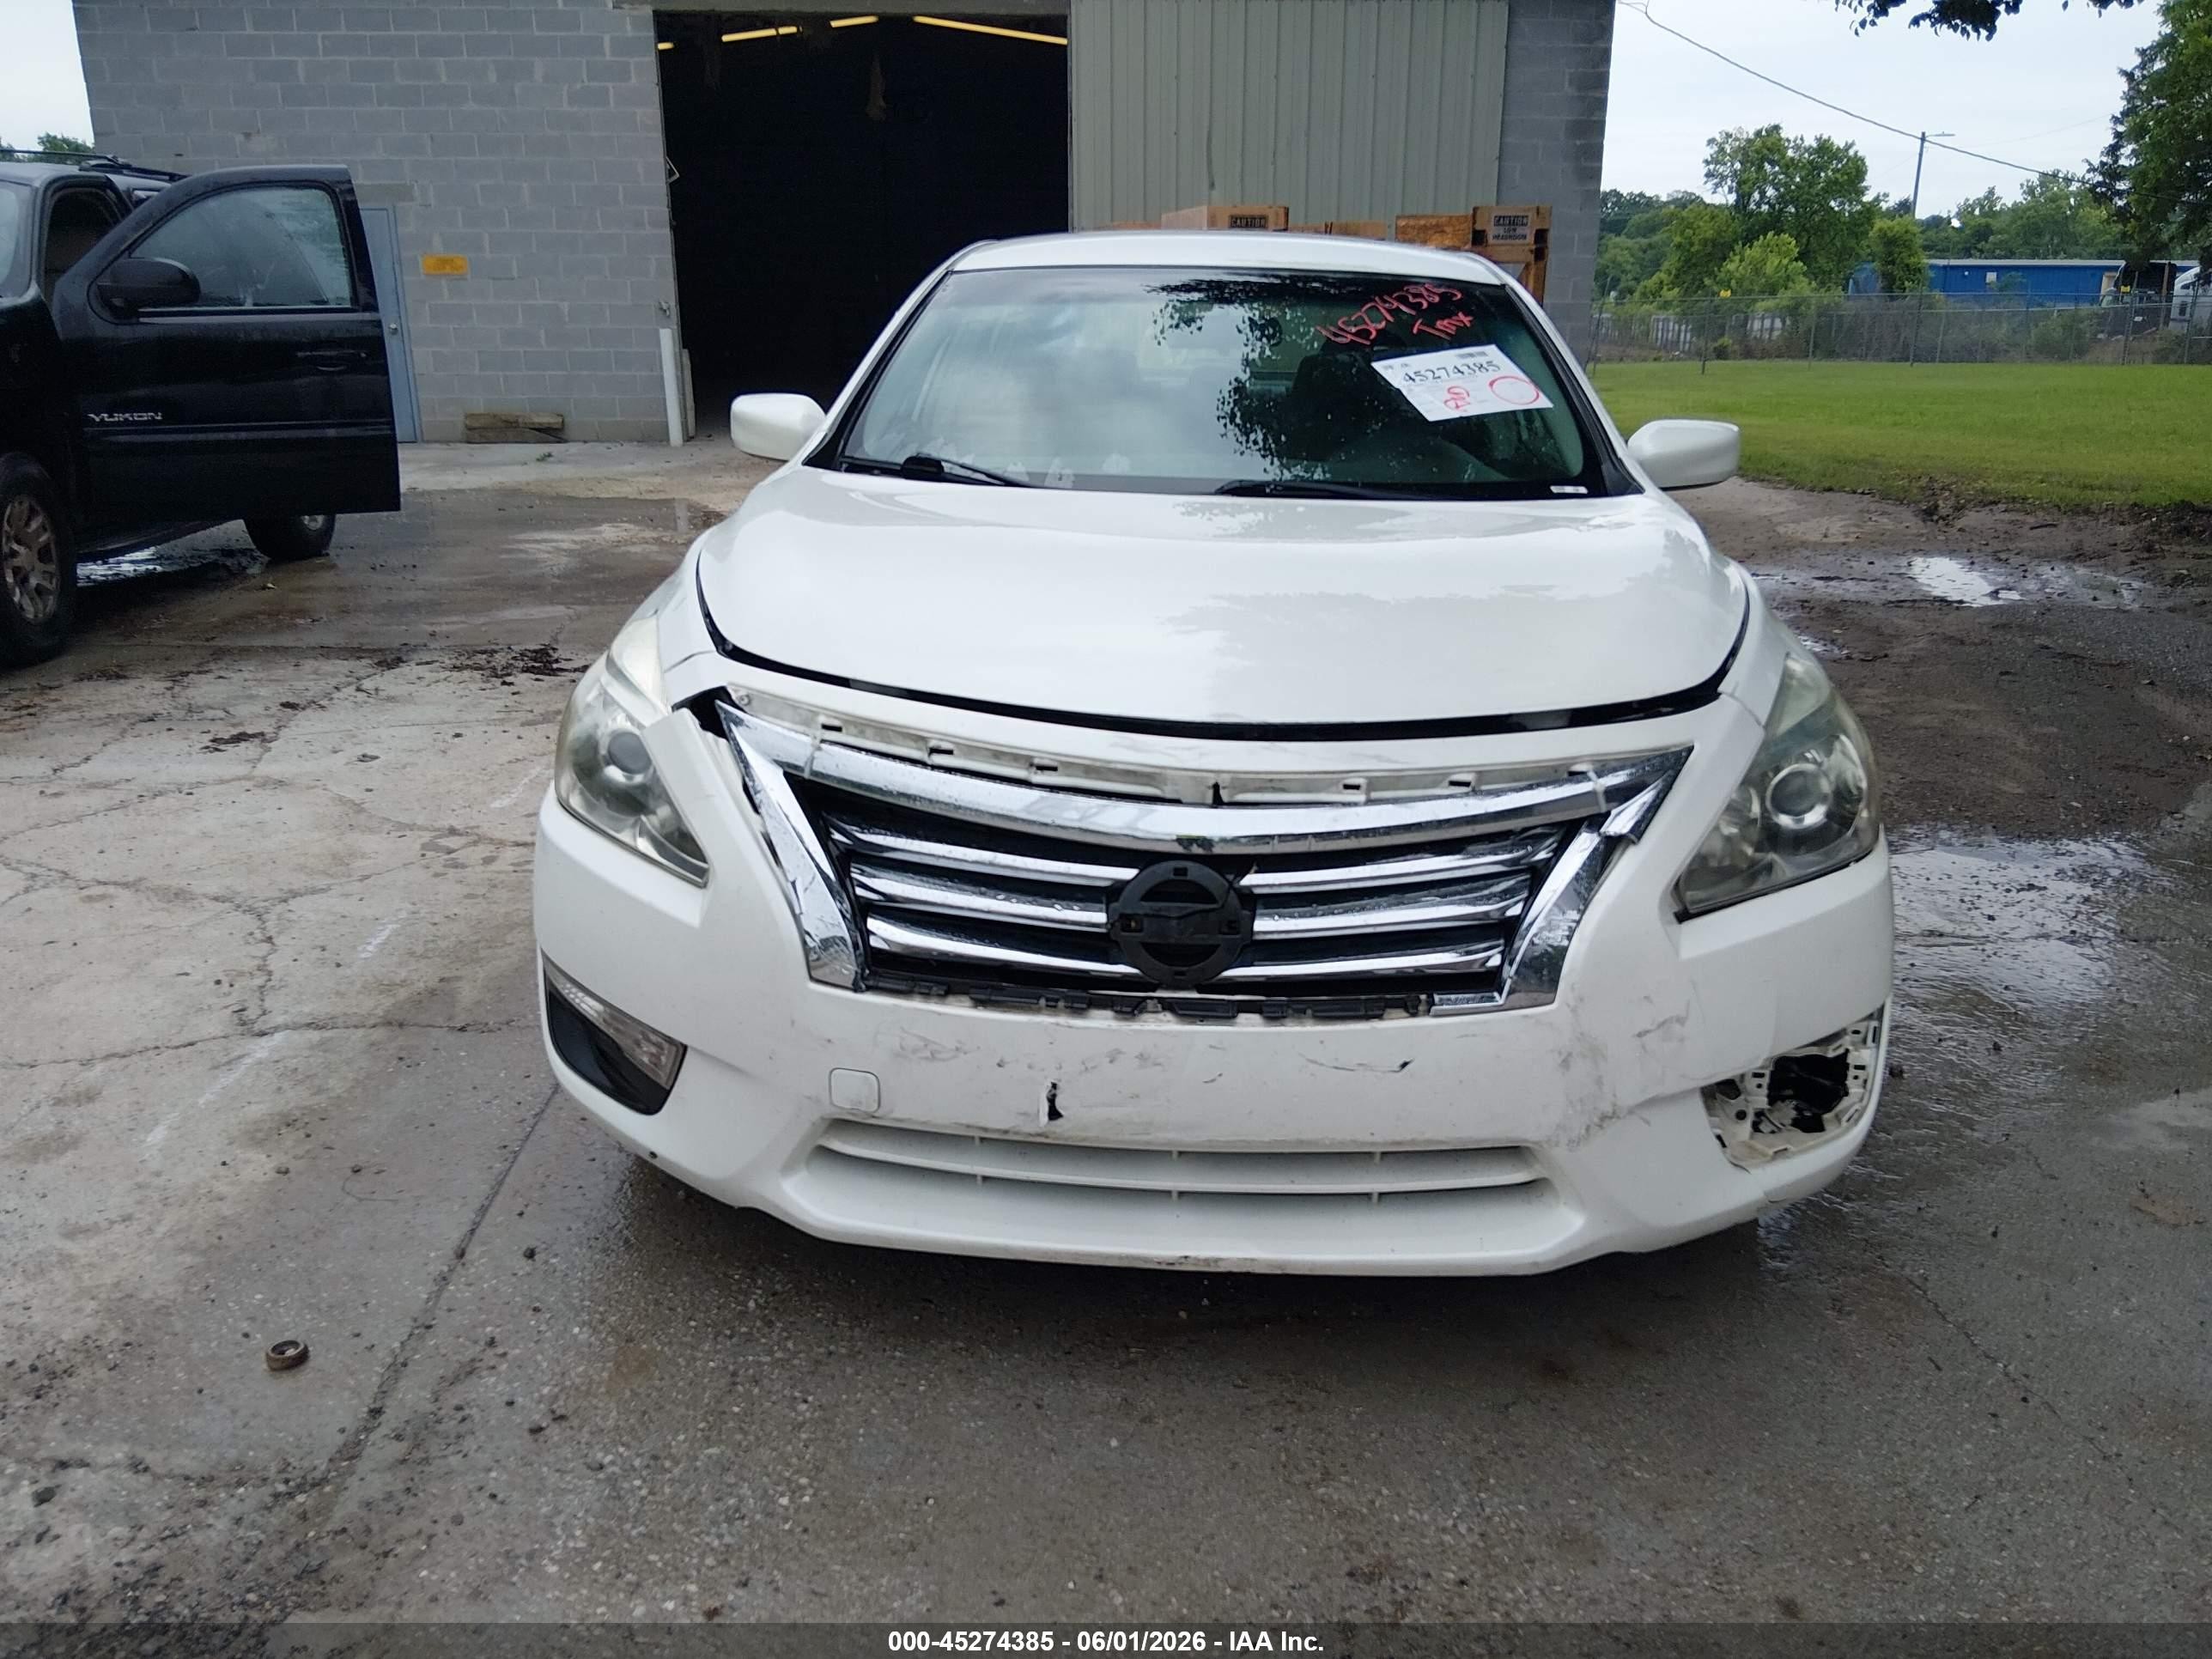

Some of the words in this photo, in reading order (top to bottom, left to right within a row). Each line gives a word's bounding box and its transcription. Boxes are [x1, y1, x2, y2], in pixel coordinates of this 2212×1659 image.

[1231, 217, 1266, 228] CAUTION
[1494, 216, 1528, 226] CAUTION
[1402, 360, 1502, 384] 45274385
[87, 412, 163, 422] YUKON
